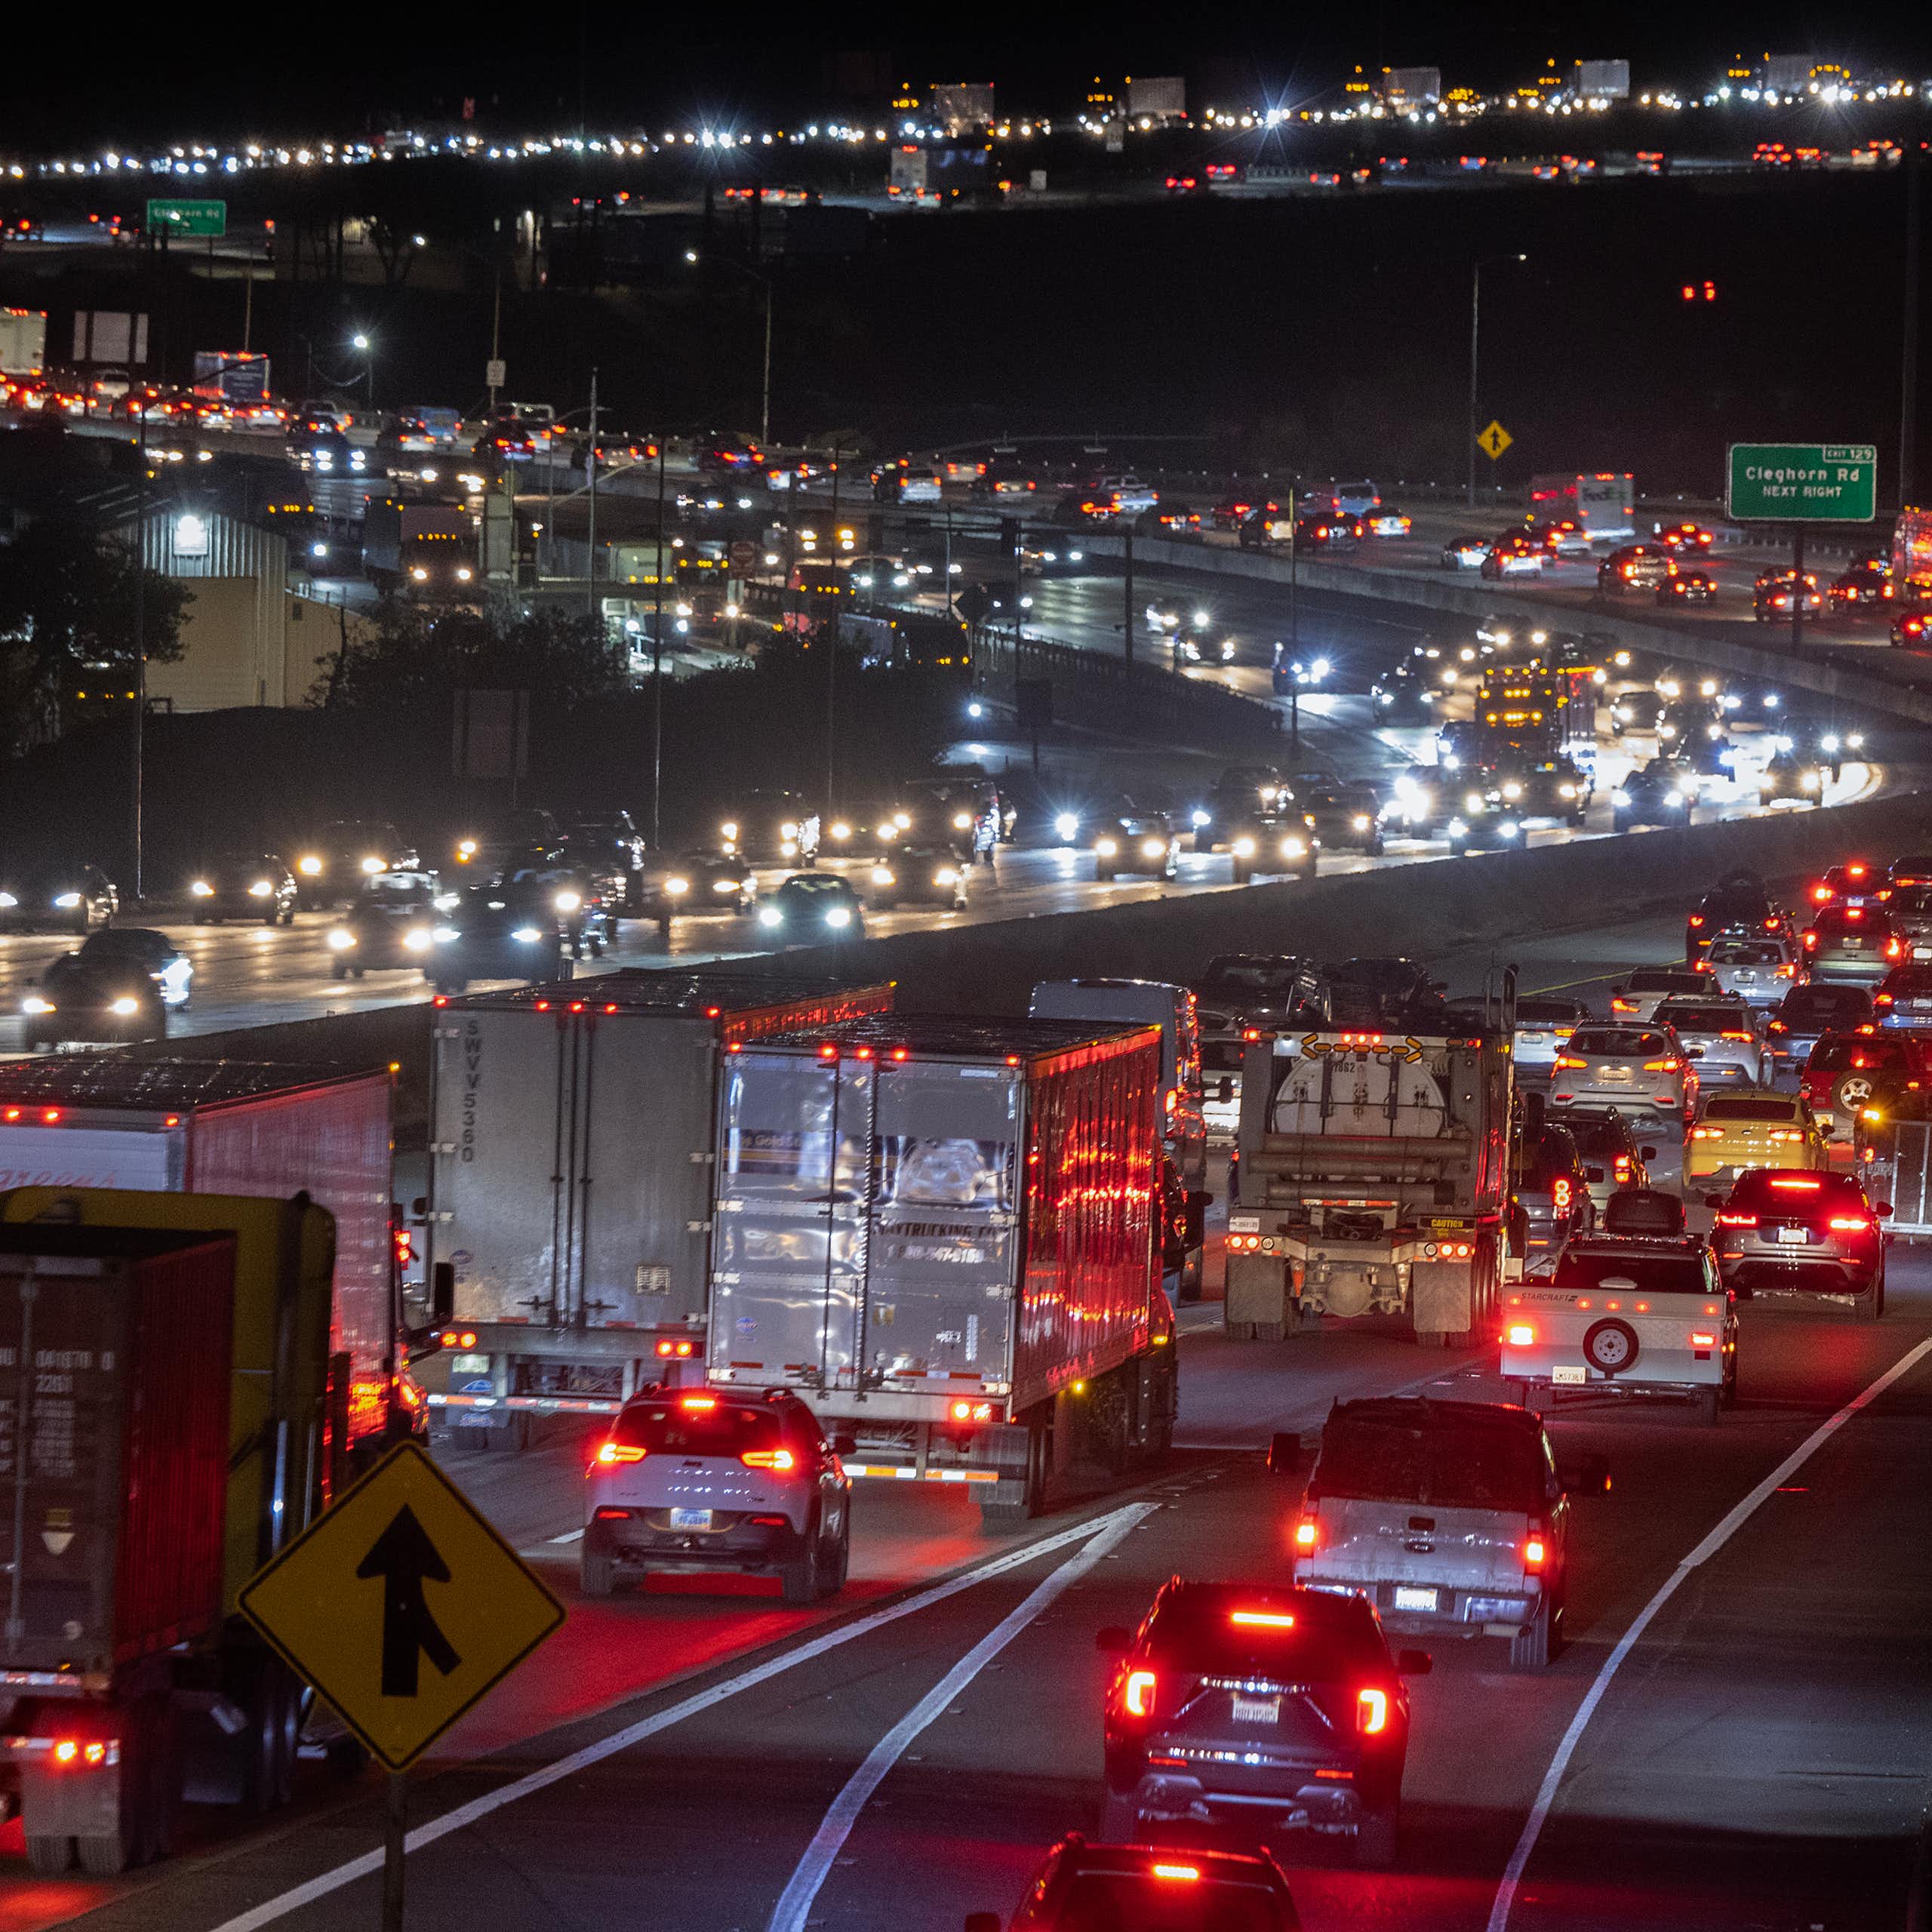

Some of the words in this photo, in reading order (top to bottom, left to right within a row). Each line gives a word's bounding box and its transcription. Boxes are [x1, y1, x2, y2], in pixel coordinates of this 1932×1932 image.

[1828, 450, 1846, 458] EXIT
[1850, 449, 1872, 460] 129
[1746, 466, 1828, 483] Cleghorn
[1837, 468, 1860, 481] Rd
[1763, 485, 1797, 497] NEXT
[1803, 486, 1842, 497] RIGHT
[1431, 1218, 1464, 1228] CAUTION
[1521, 1292, 1570, 1302] STARCRAFT
